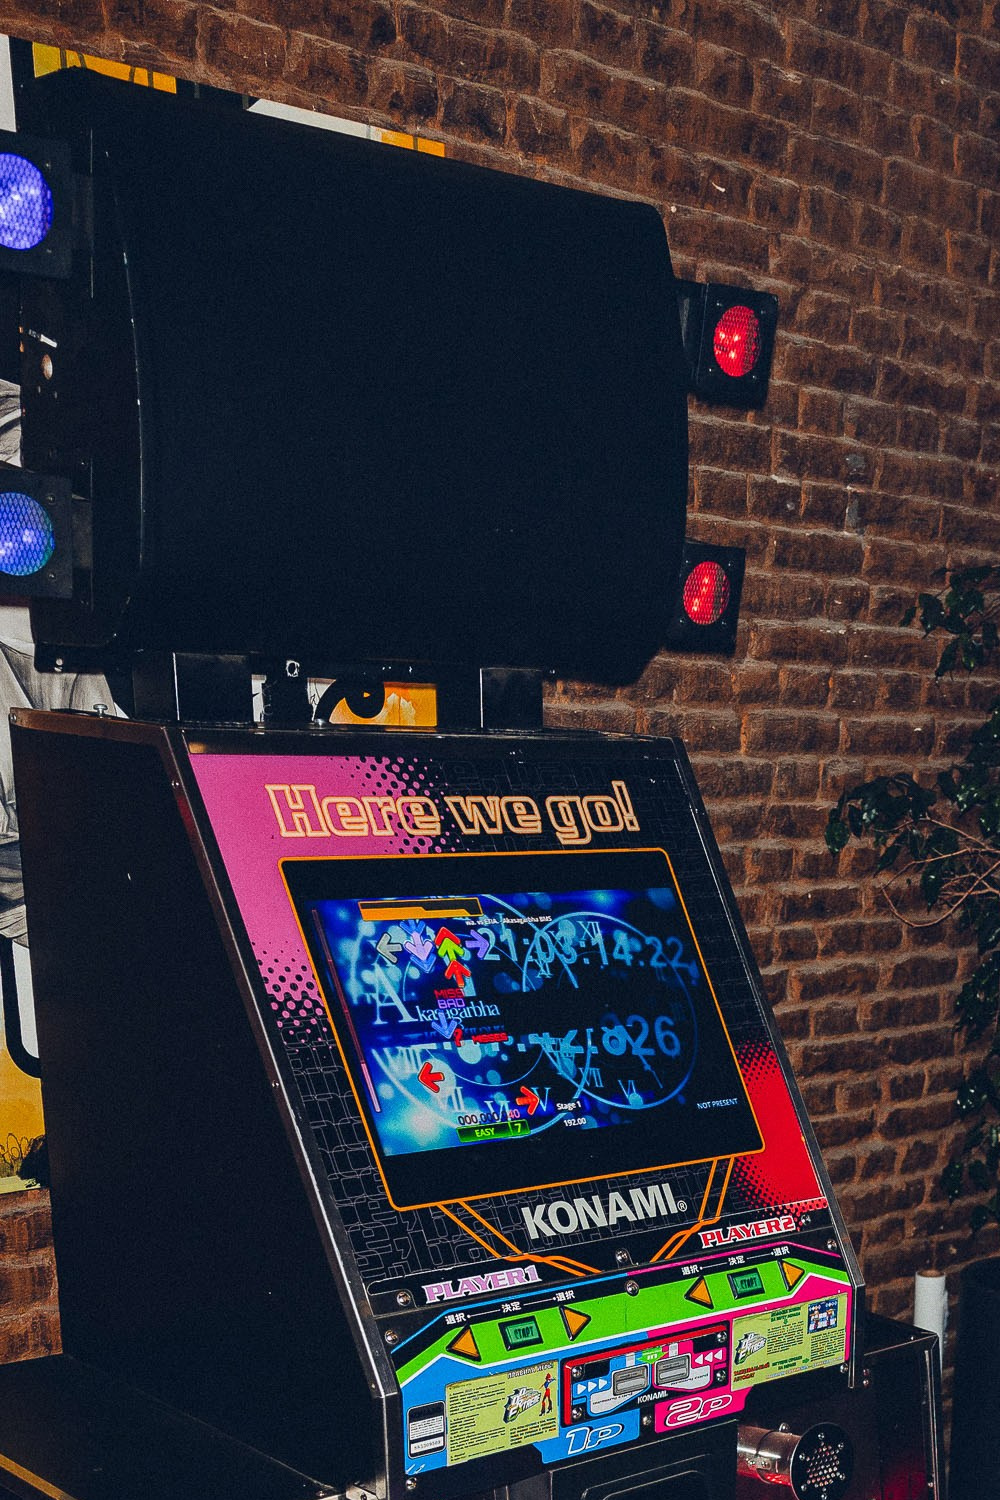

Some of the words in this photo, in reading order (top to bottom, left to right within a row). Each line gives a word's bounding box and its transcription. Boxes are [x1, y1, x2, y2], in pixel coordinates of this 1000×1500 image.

[264, 783, 441, 837] Here
[444, 795, 542, 835] we
[546, 780, 641, 845] go!
[434, 988, 466, 999] MISS
[437, 998, 466, 1009] BAD
[556, 1101, 576, 1111] Stage
[697, 1101, 712, 1110] NOT
[712, 1097, 738, 1108] PRESENT
[563, 1117, 588, 1127] 192.00
[474, 1127, 495, 1138] EASY
[514, 1122, 521, 1133] 7
[698, 1215, 797, 1249] PLAYER2
[421, 1264, 543, 1305] PLAYER1
[501, 1301, 522, 1313] 決定
